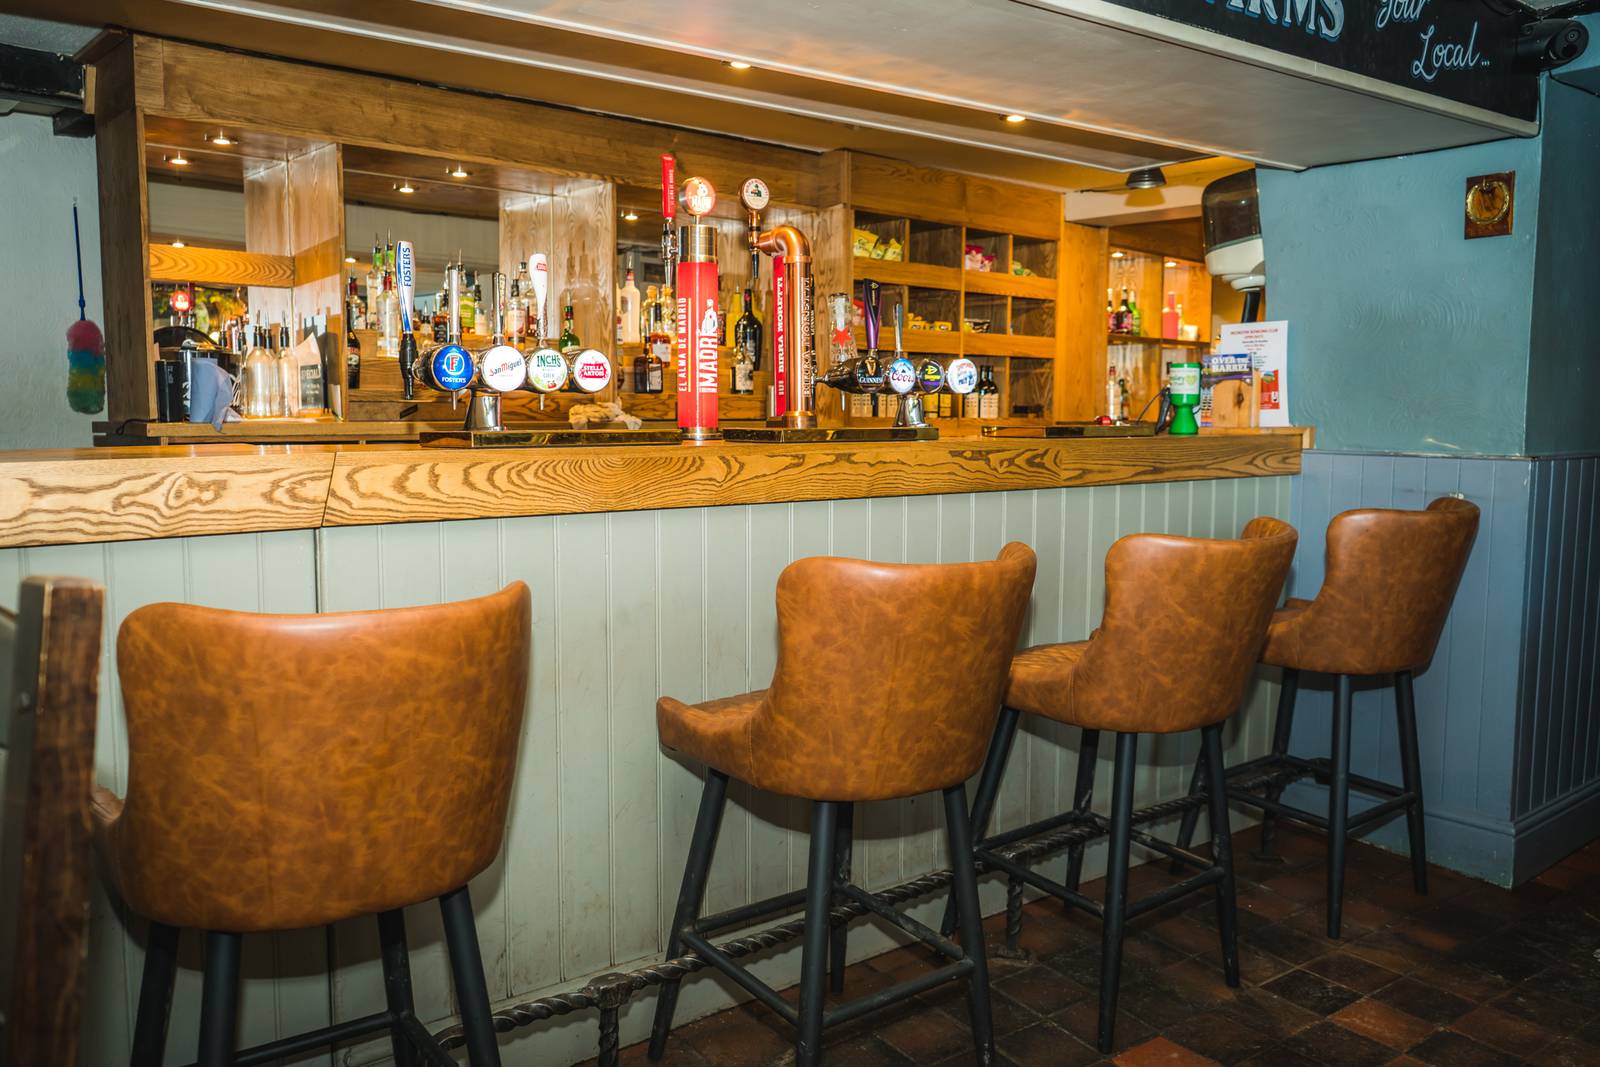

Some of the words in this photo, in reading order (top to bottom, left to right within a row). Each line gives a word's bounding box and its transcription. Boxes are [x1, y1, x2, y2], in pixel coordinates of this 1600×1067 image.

[678, 297, 687, 334] MADRID
[678, 337, 687, 349] DE
[678, 353, 687, 378] ALMA
[1212, 363, 1249, 372] BARREL
[678, 382, 687, 392] EL
